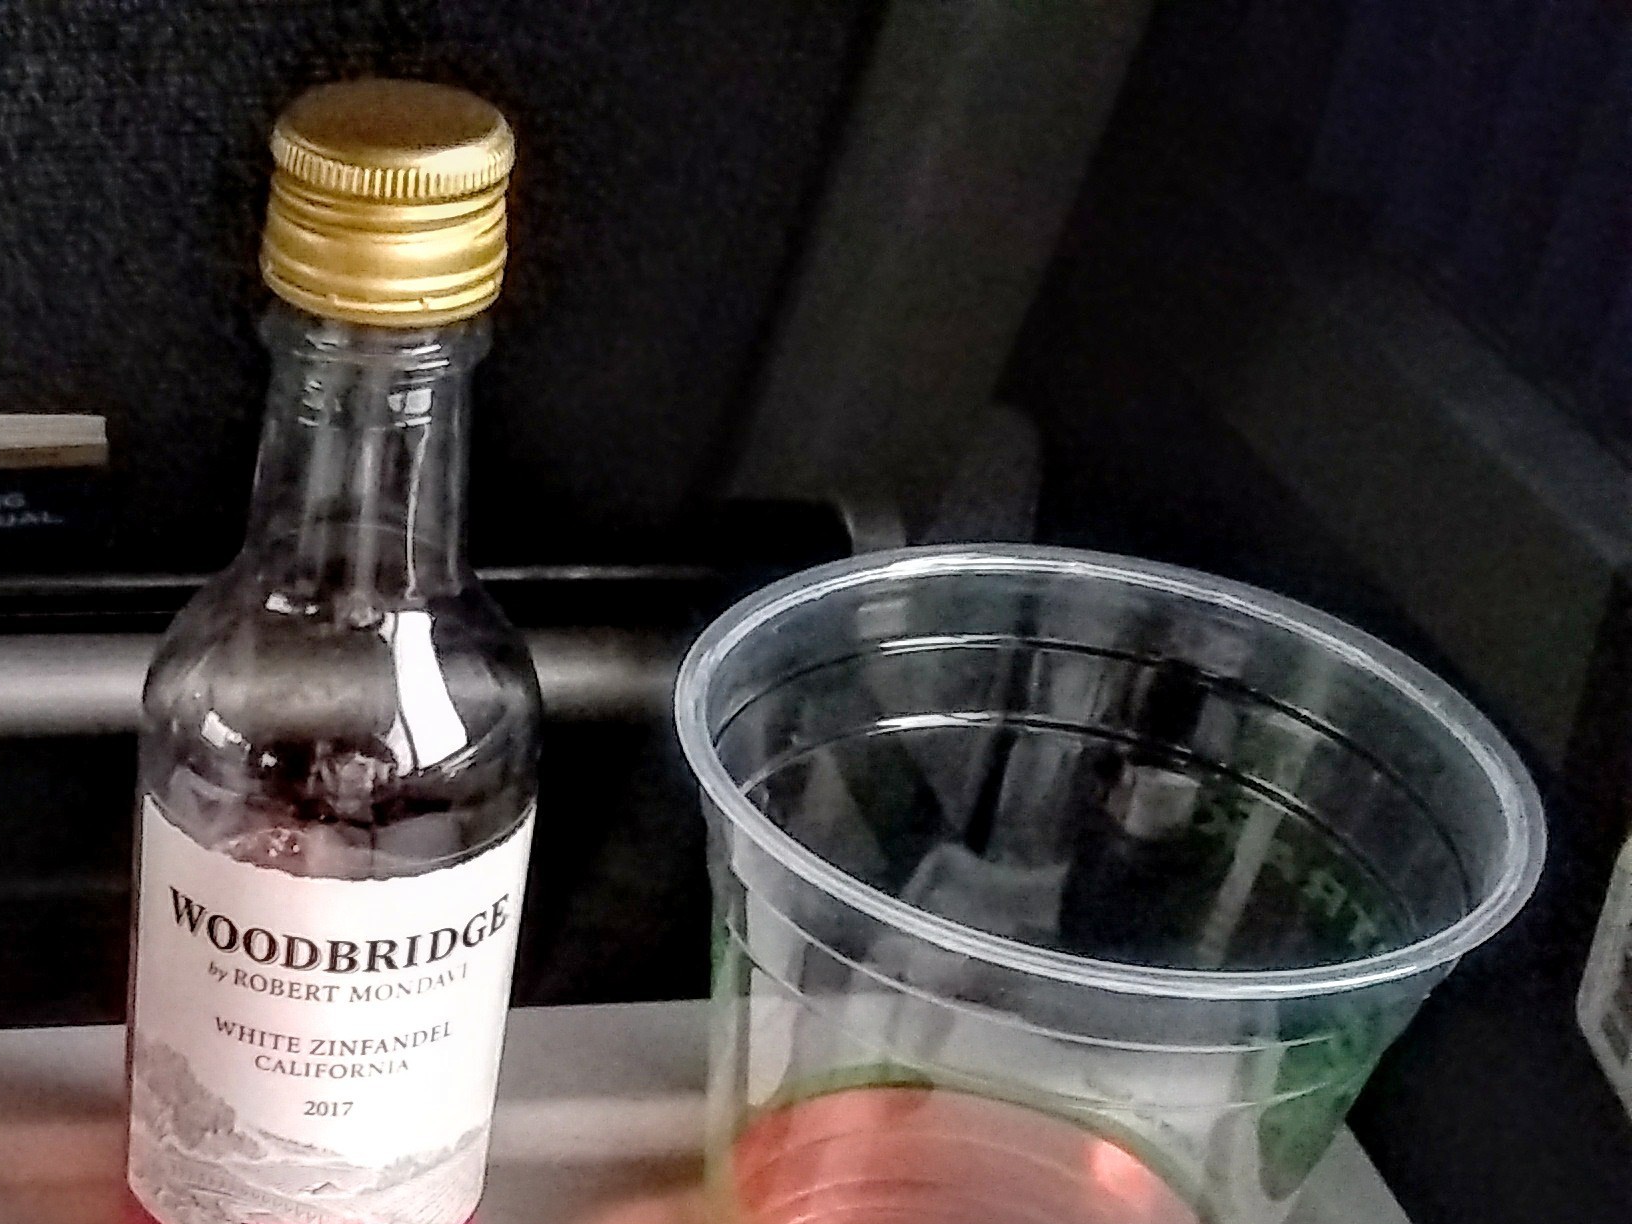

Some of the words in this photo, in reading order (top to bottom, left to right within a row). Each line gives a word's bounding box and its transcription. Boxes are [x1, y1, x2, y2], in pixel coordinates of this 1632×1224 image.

[170, 885, 510, 975] WOODBRIDGE
[207, 961, 227, 983] by
[234, 966, 340, 1003] ROBERT
[215, 1016, 301, 1053] WHITE
[308, 1021, 453, 1056] ZINFANDEL
[254, 1054, 410, 1080] CALIFORNIA
[303, 1101, 355, 1118] 2017
